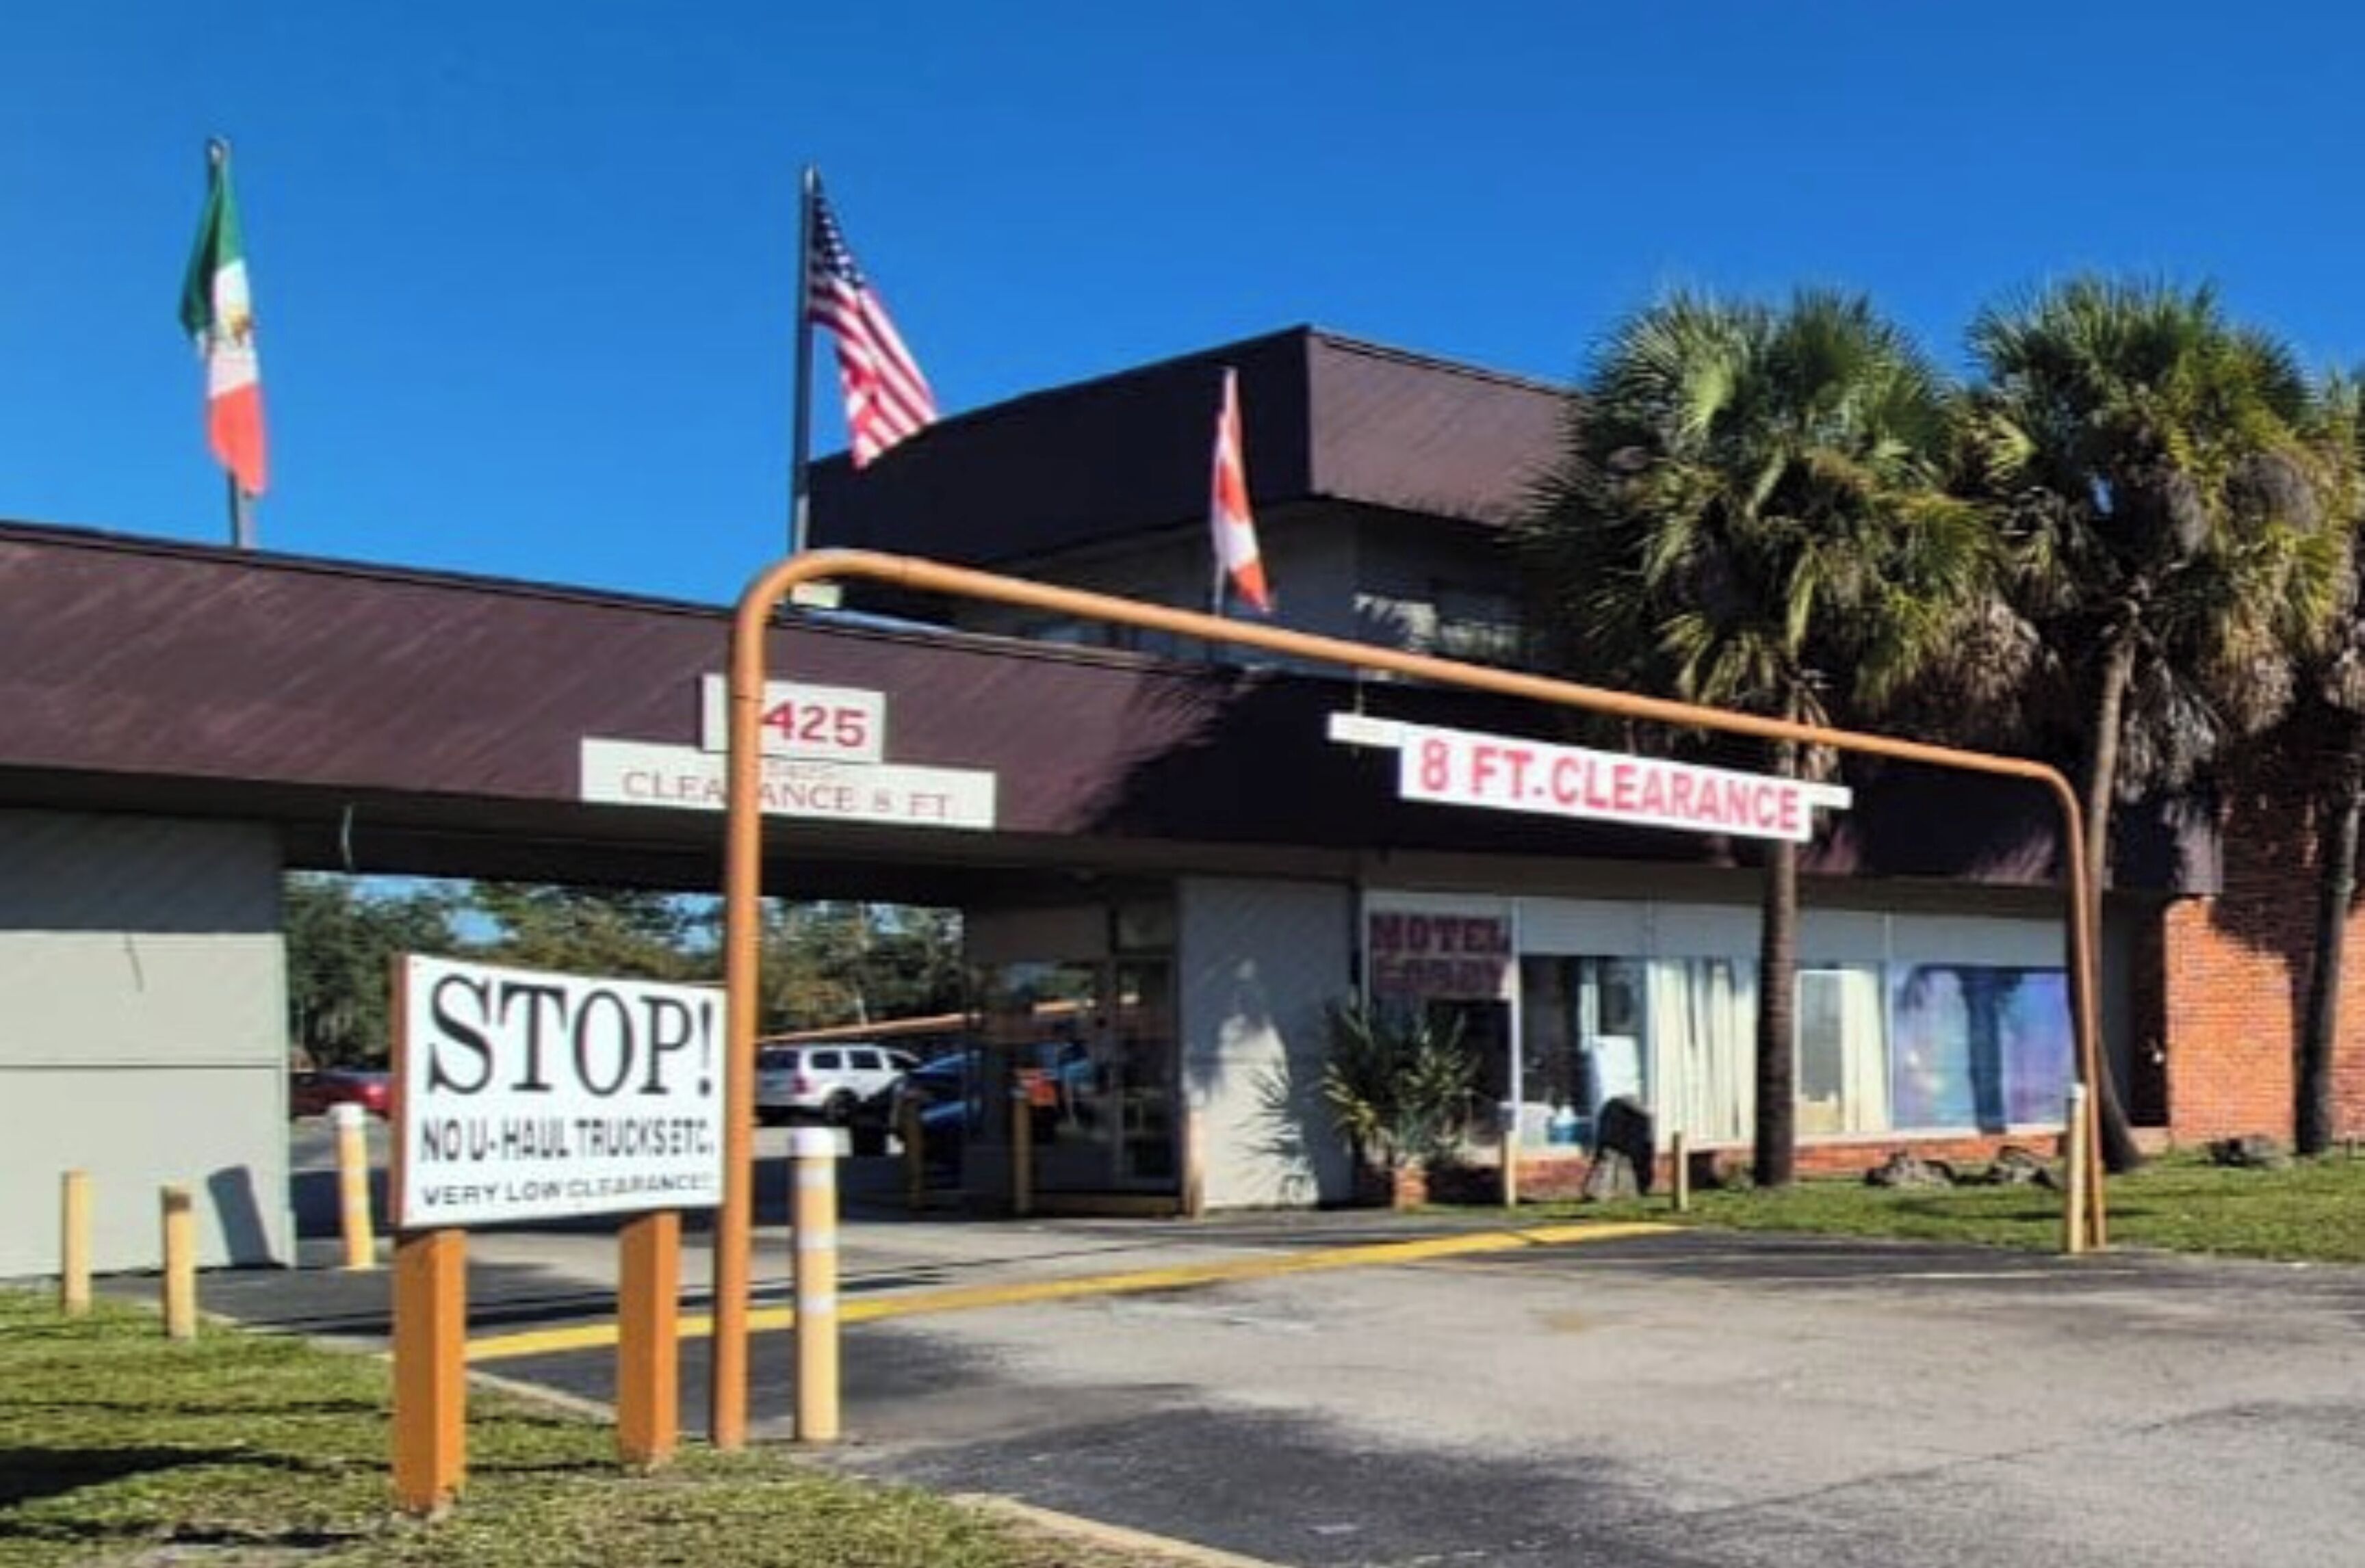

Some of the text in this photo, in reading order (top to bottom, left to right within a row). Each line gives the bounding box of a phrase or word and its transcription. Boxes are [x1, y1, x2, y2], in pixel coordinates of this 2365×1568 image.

[1419, 737, 1450, 792] 8
[622, 770, 857, 813] CLEAANCE
[1371, 913, 1511, 954] MOTEL
[427, 974, 712, 1098] STOP!
[421, 1118, 462, 1162] NO
[469, 1117, 569, 1160] U-HAUL
[422, 1181, 500, 1206] VERY
[505, 1179, 562, 1203] LOW
